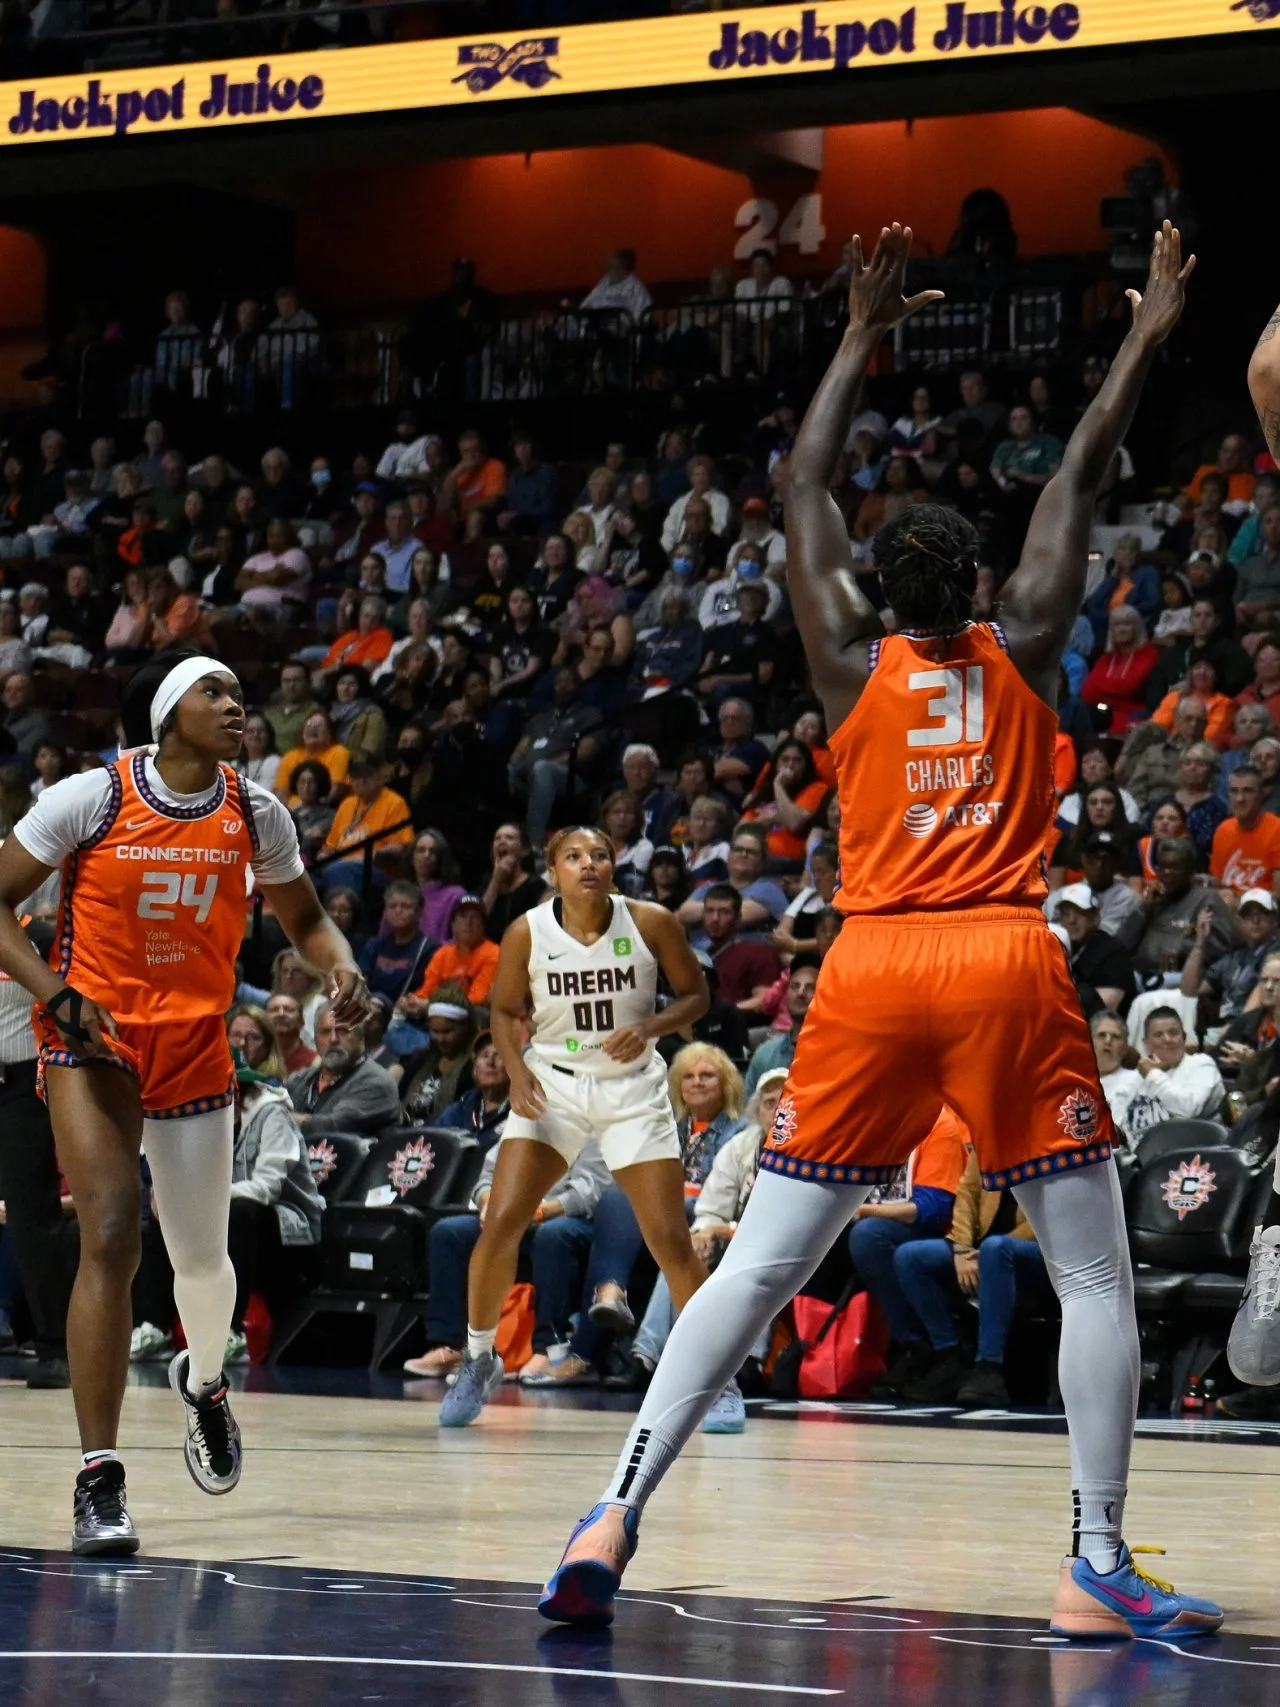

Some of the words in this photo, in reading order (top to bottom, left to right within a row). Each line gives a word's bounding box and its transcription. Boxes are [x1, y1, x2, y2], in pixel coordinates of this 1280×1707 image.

[708, 8, 917, 70] Jackpot
[933, 0, 1081, 51] Juice
[8, 79, 185, 135] Jackpot
[199, 63, 325, 118] Juice
[733, 193, 827, 260] 24
[907, 666, 984, 747] 31
[905, 754, 994, 793] CHARLES
[942, 802, 1003, 827] AT&T
[116, 845, 240, 865] CONNECTICUT
[137, 871, 219, 924] 24
[145, 930, 170, 941] Yale
[146, 952, 186, 967] Health
[546, 964, 636, 996] DREAM
[573, 1000, 614, 1031] 00
